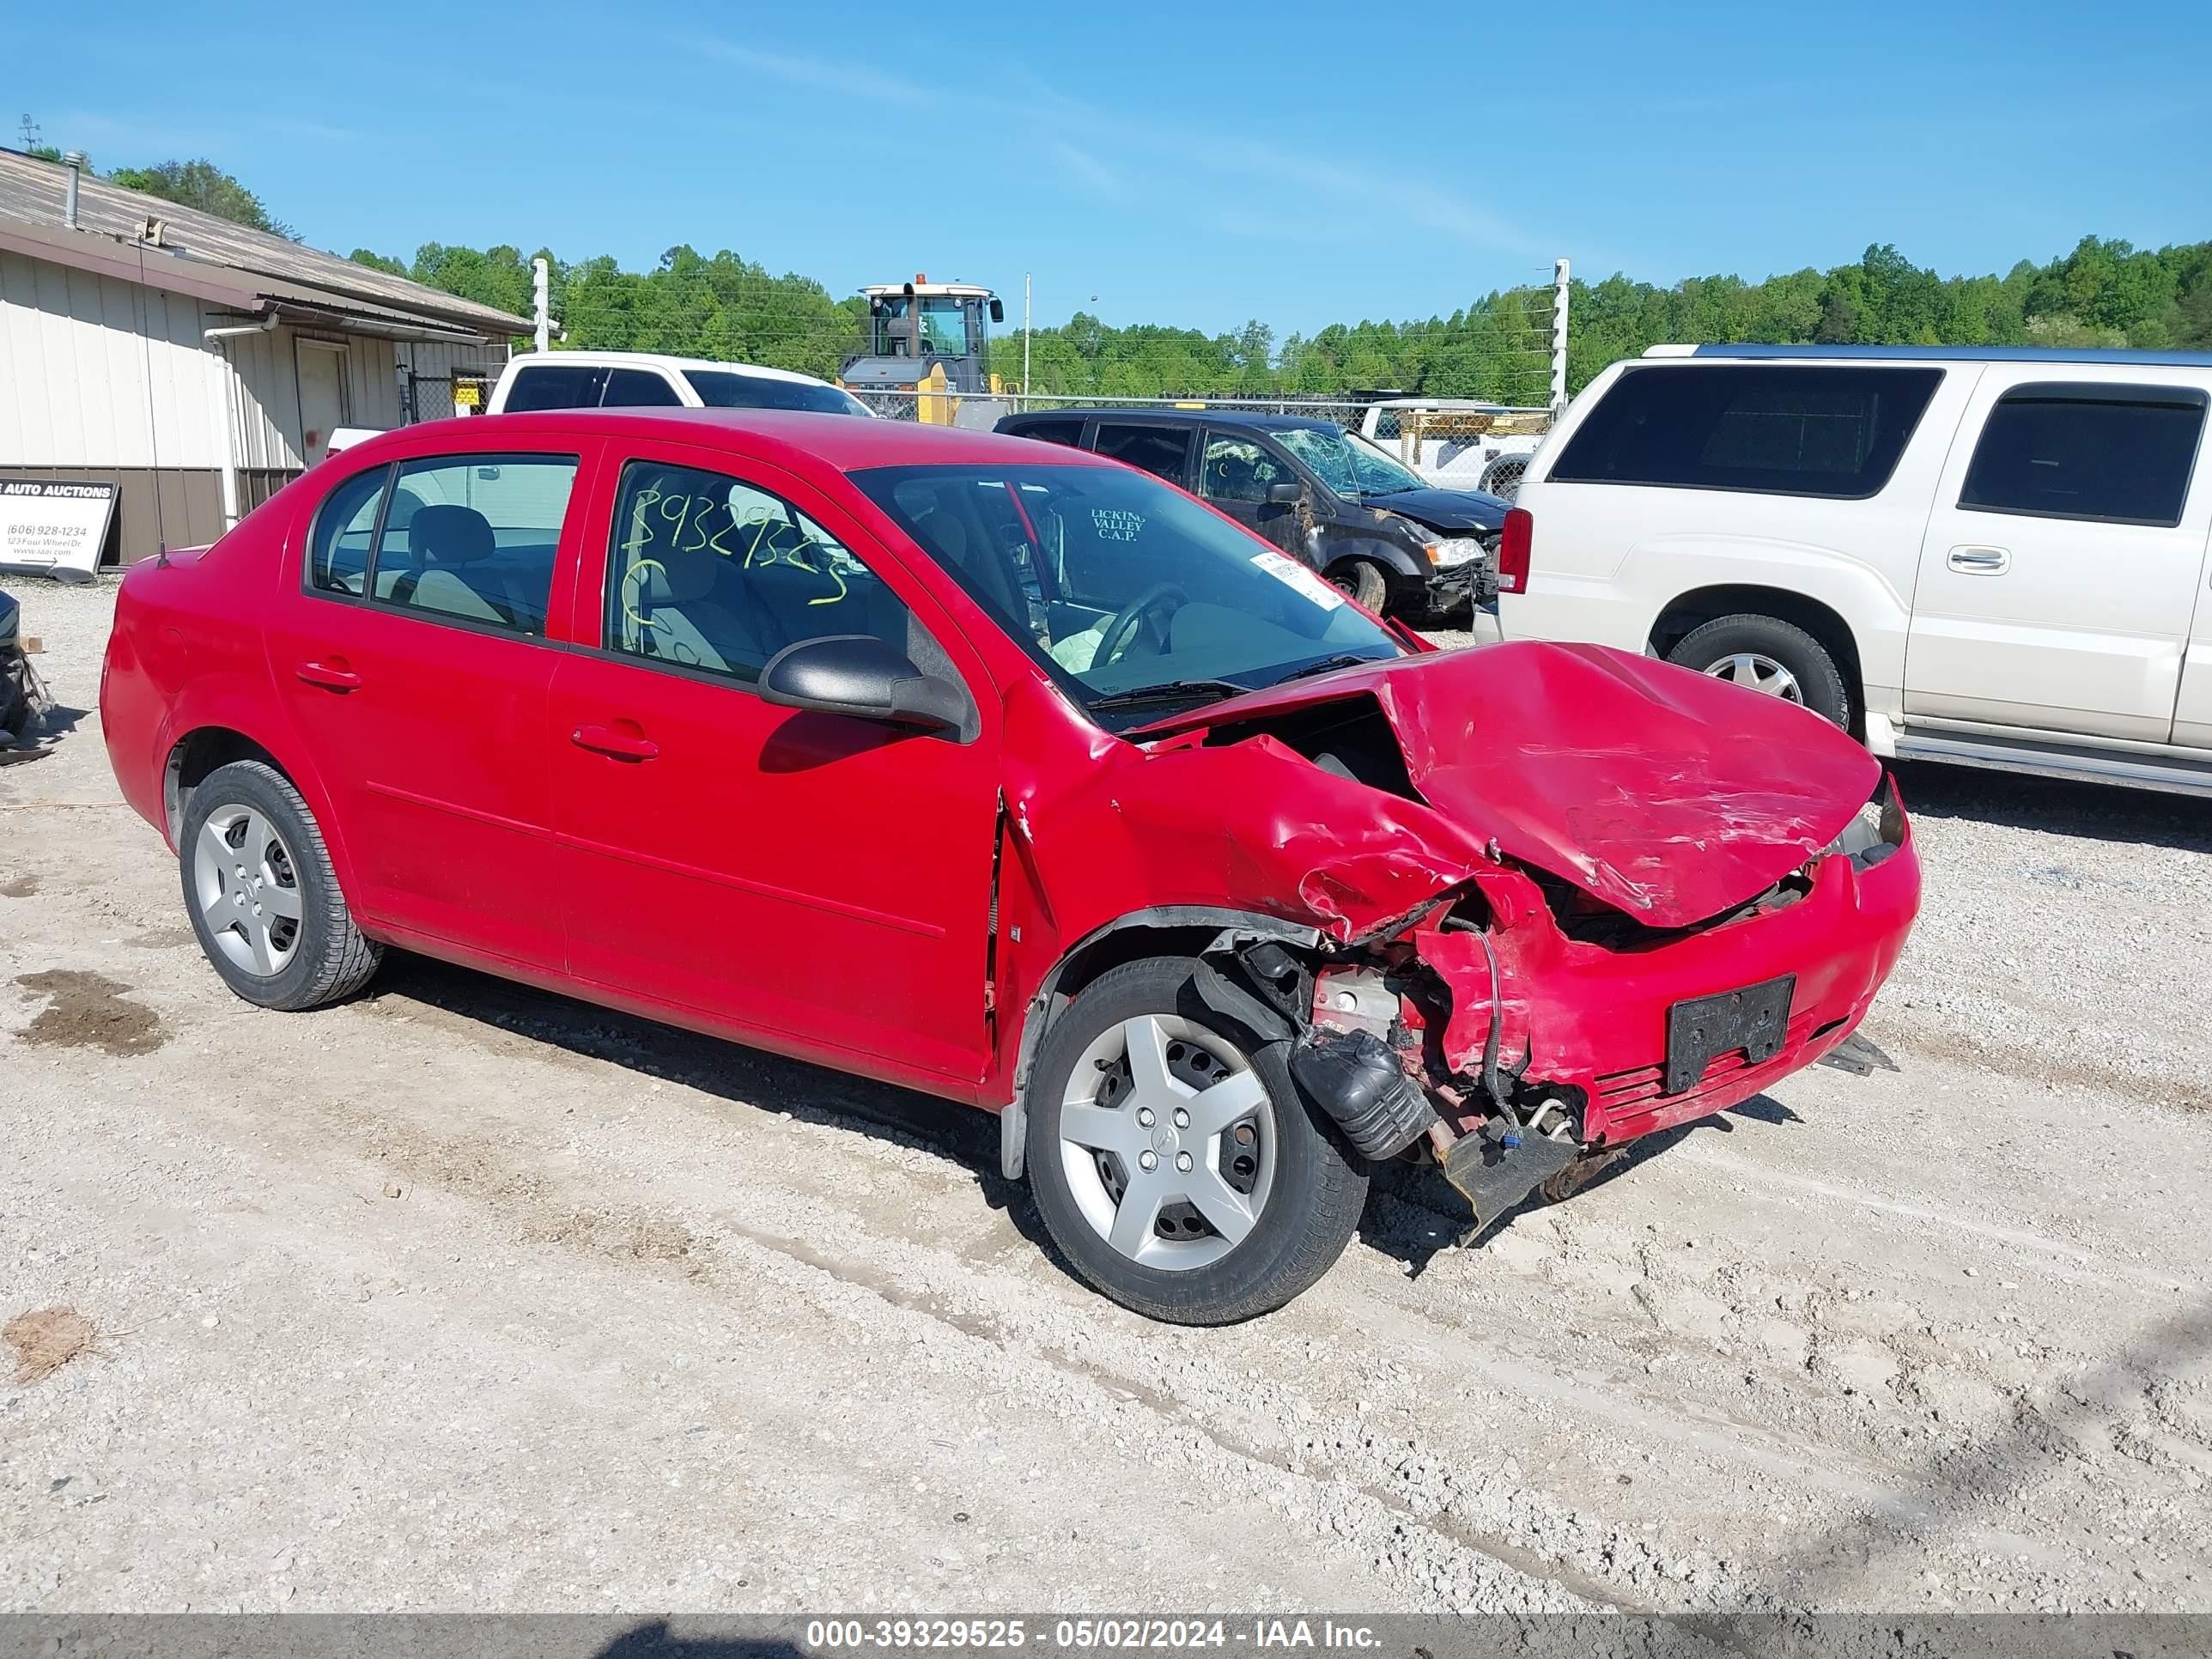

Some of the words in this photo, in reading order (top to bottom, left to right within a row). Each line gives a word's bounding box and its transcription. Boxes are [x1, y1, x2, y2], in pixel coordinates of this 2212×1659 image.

[3, 483, 42, 495] AUTO
[43, 484, 112, 498] AUCTIONS
[8, 524, 35, 536] (606)
[37, 525, 88, 537] 928-1234
[1093, 518, 1143, 532] VALLEY
[21, 537, 41, 546] Four
[43, 538, 70, 547] Wheel
[1098, 528, 1138, 542] C.A.P.
